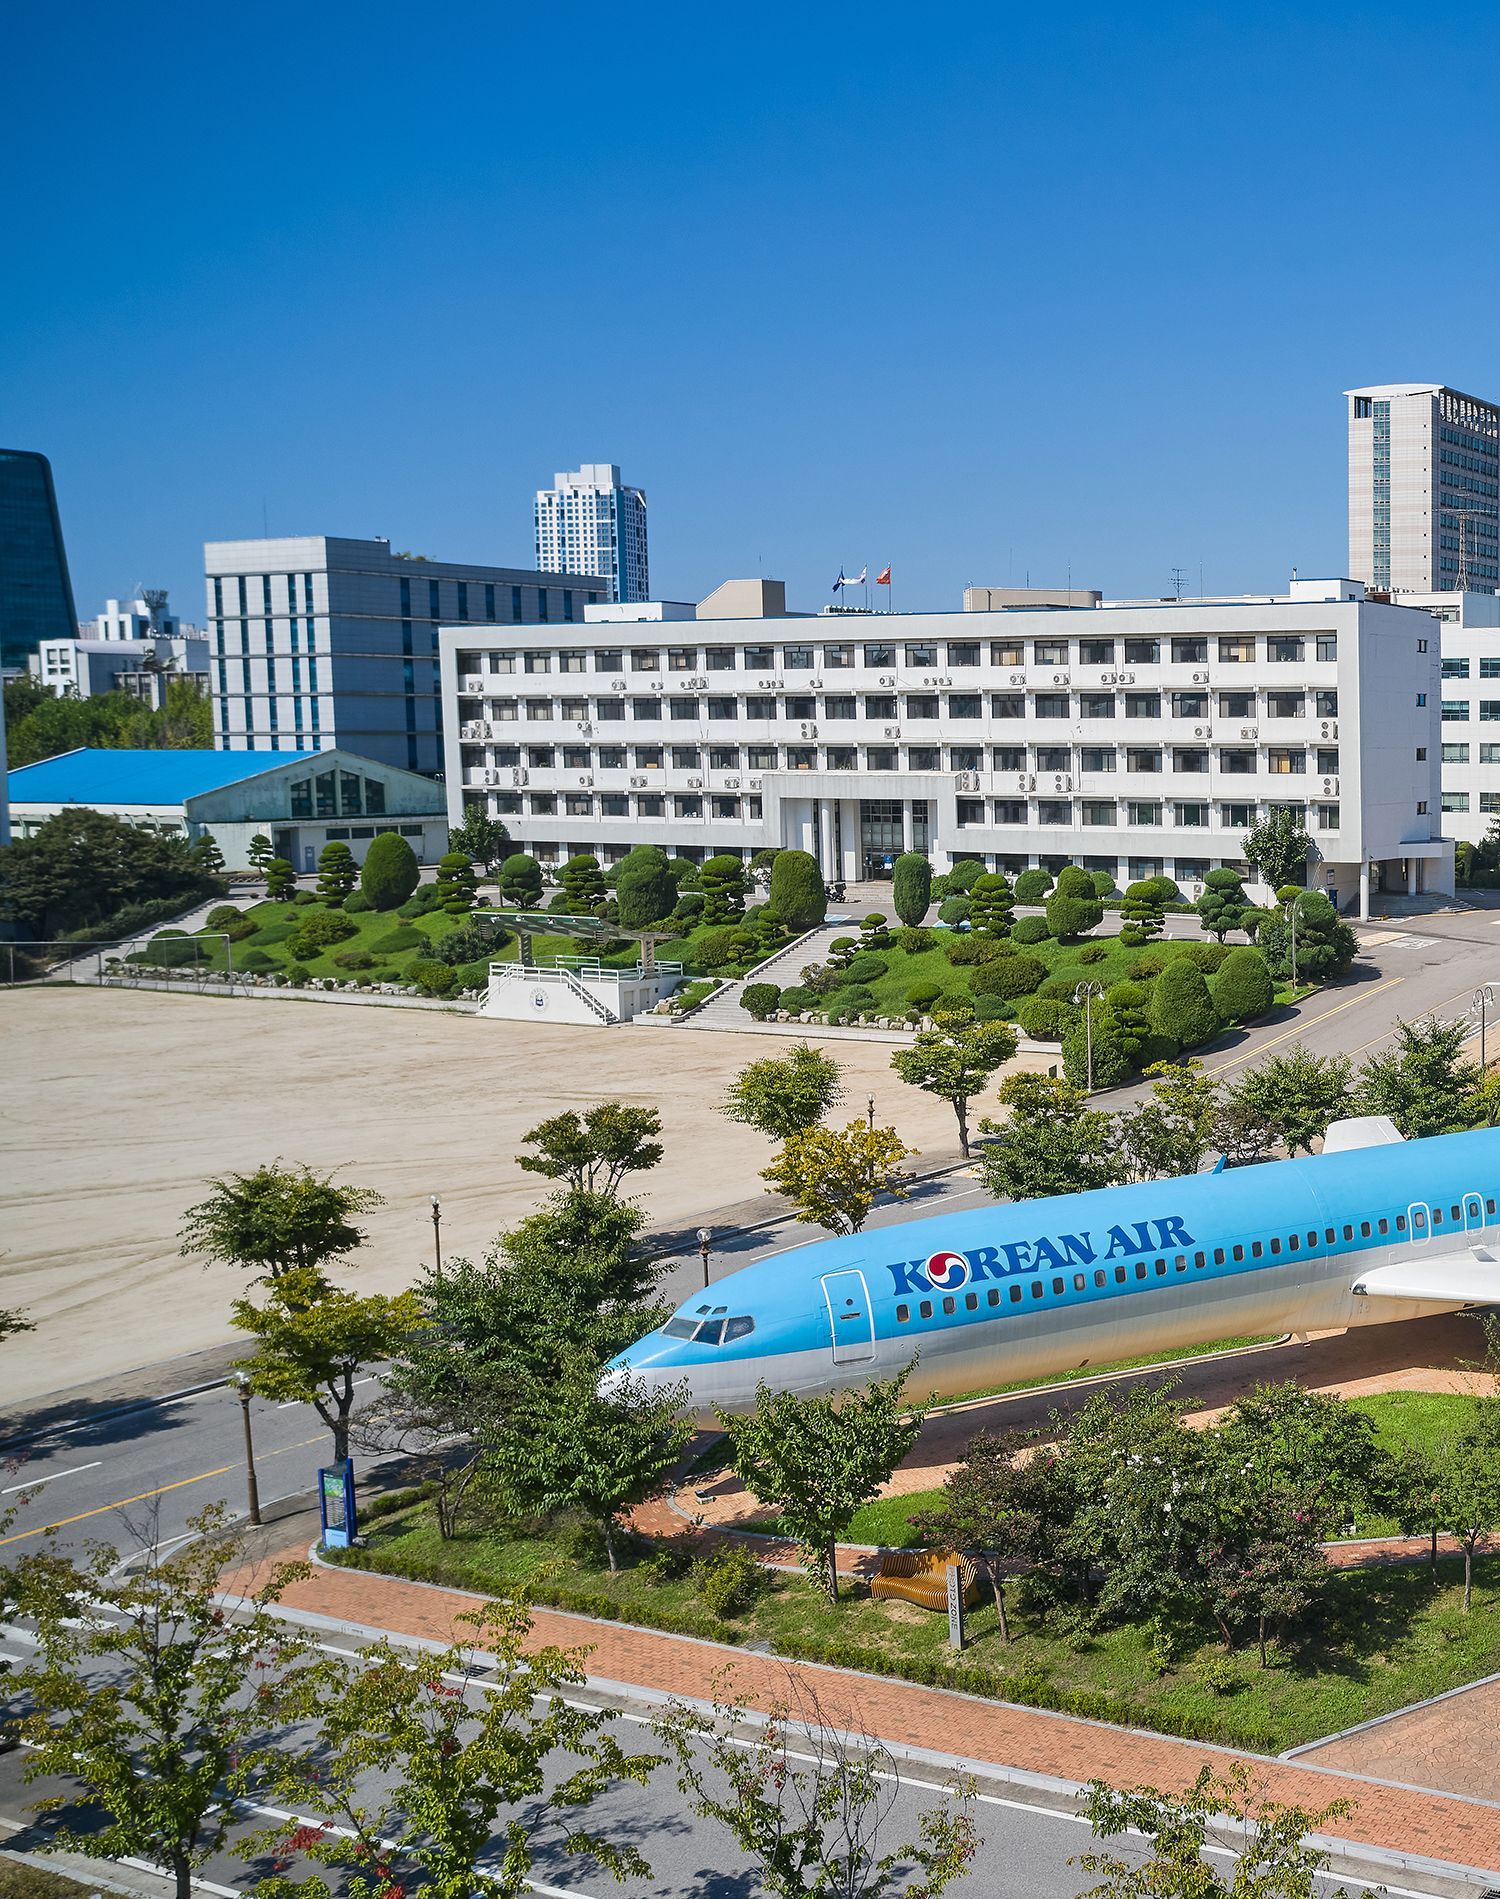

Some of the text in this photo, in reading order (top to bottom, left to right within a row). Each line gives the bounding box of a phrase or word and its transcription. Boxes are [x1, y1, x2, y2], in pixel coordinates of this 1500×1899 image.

[886, 1215, 1195, 1296] KOREAN AIR
[949, 1602, 959, 1631] ZONE
